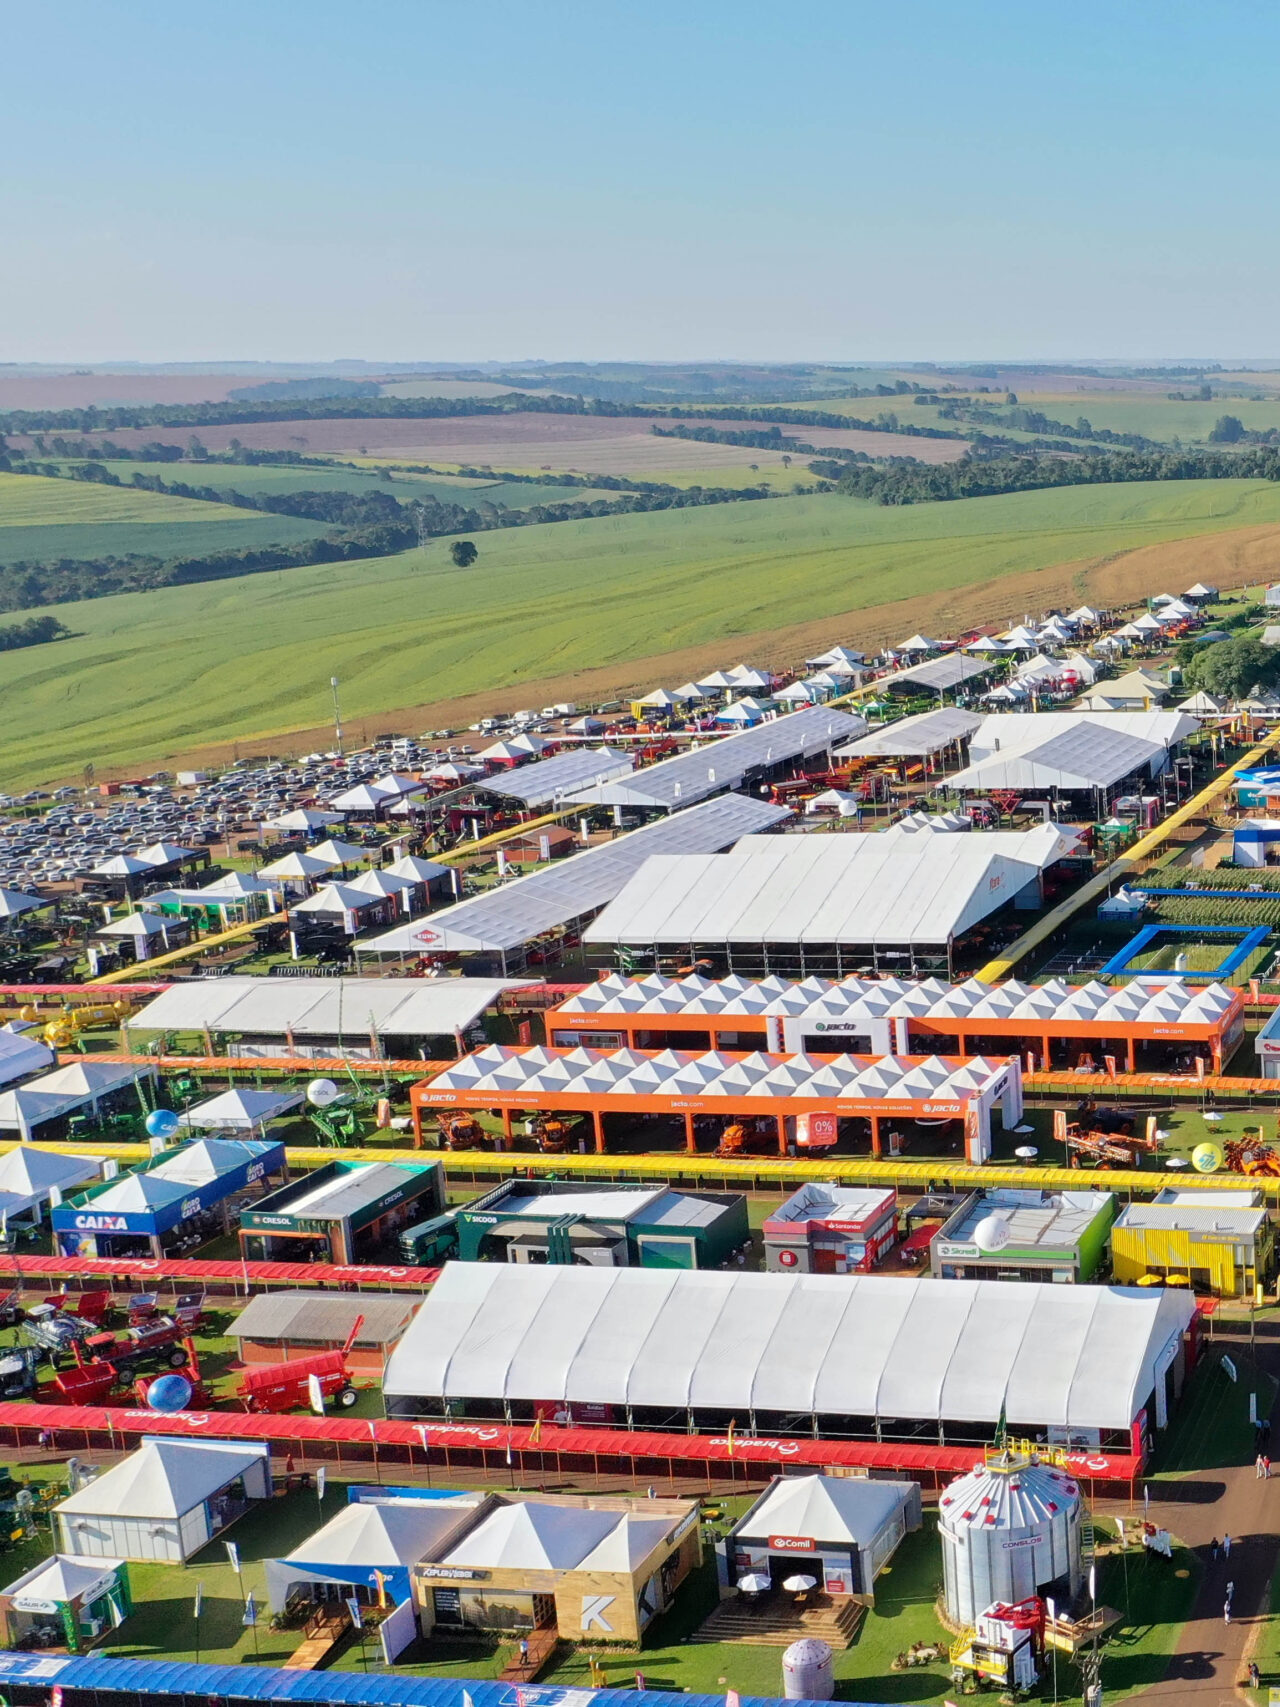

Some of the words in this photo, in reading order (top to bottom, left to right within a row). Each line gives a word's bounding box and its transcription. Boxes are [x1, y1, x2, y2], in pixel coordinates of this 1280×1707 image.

[825, 1022, 856, 1031] jacto
[428, 1093, 458, 1102] jacto
[932, 1105, 961, 1113] jacto
[815, 1121, 833, 1133] 0%
[384, 1191, 404, 1206] CRESOL
[75, 1215, 128, 1230] CAIXA
[262, 1217, 292, 1225] CRESOL
[472, 1216, 498, 1224] SICOOB
[952, 1247, 977, 1256] Sicredi
[412, 1424, 482, 1434] bradesco
[785, 1540, 811, 1549] Comil
[368, 1573, 394, 1583] pe
[581, 1595, 617, 1631] K
